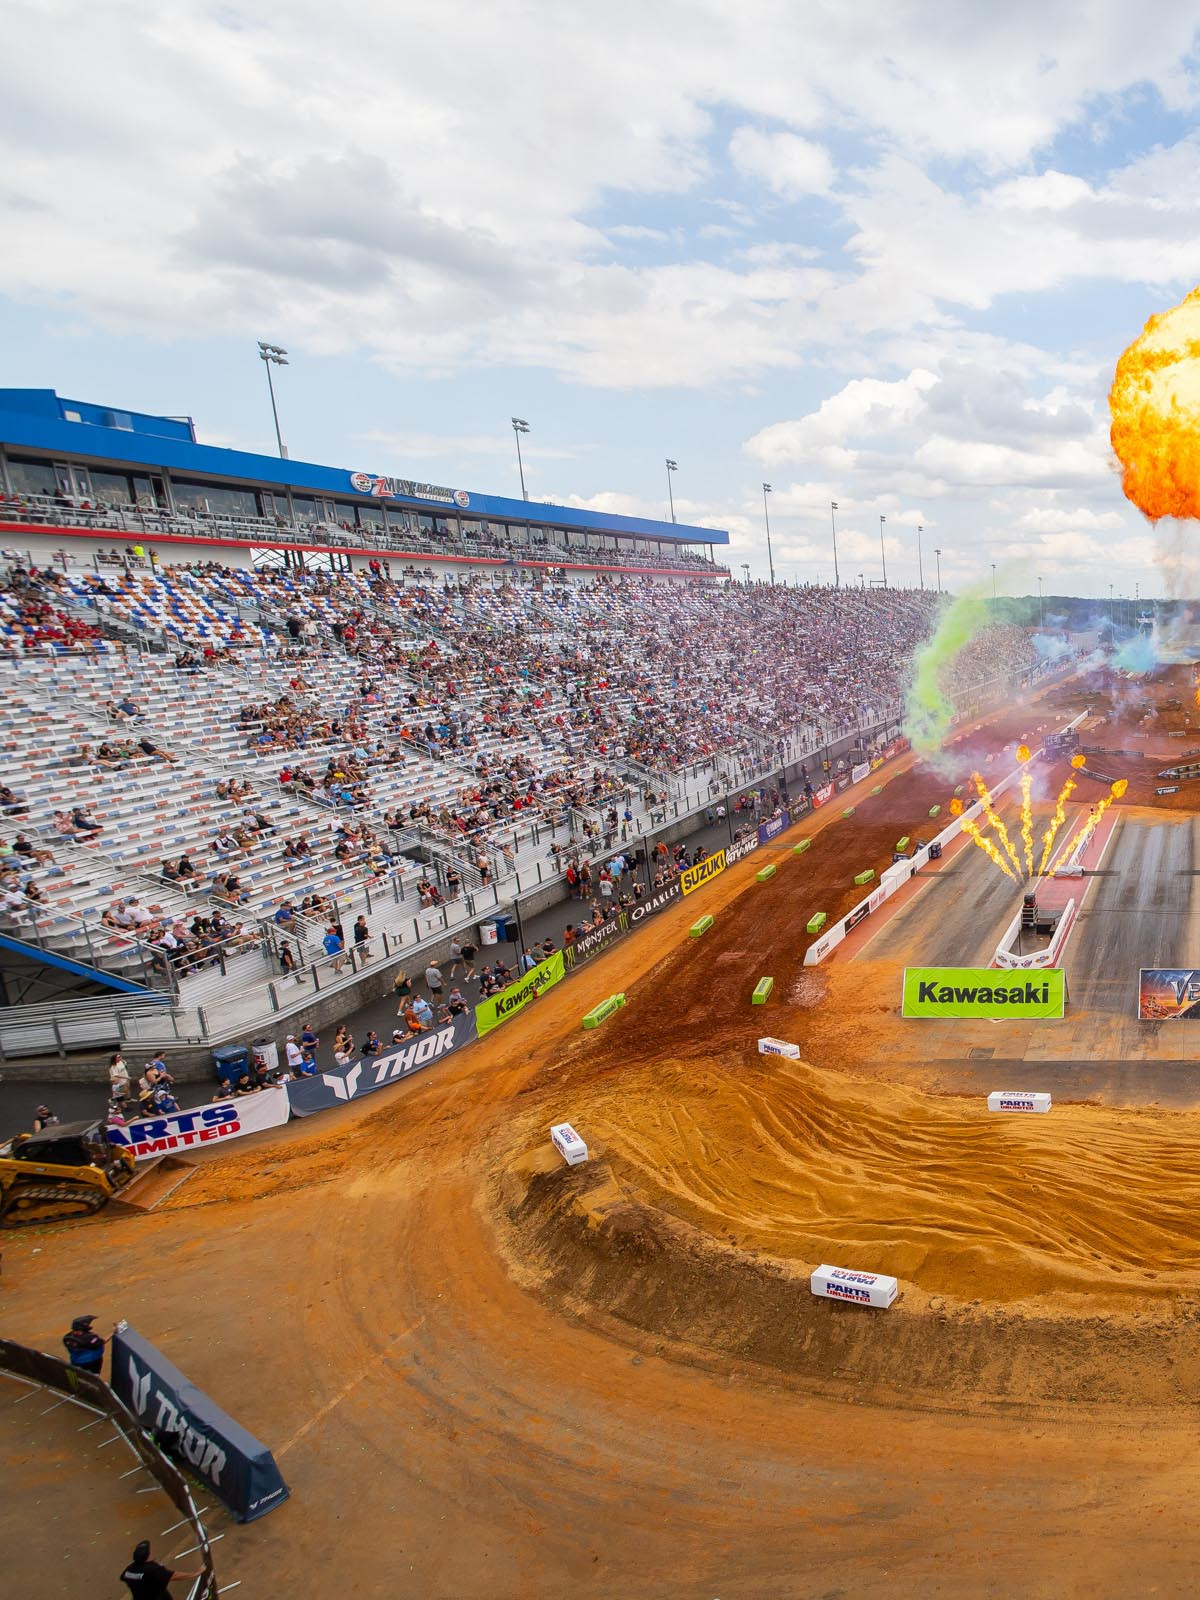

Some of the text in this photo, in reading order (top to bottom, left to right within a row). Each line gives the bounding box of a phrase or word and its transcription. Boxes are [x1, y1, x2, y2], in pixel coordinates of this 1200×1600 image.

[683, 858, 725, 890] SUZUKI
[645, 883, 680, 912] OAKLEY
[577, 921, 618, 953] MONSTER
[495, 966, 552, 1018] Kawasaki
[918, 982, 1049, 1004] Kawasaki
[372, 1026, 455, 1083] THOR
[106, 1103, 239, 1146] ARTS
[124, 1121, 241, 1156] IMITED
[827, 1283, 870, 1298] PARTS
[831, 1273, 875, 1286] PARTS
[827, 1290, 871, 1302] UNLIMITED
[155, 1390, 227, 1487] THOR
